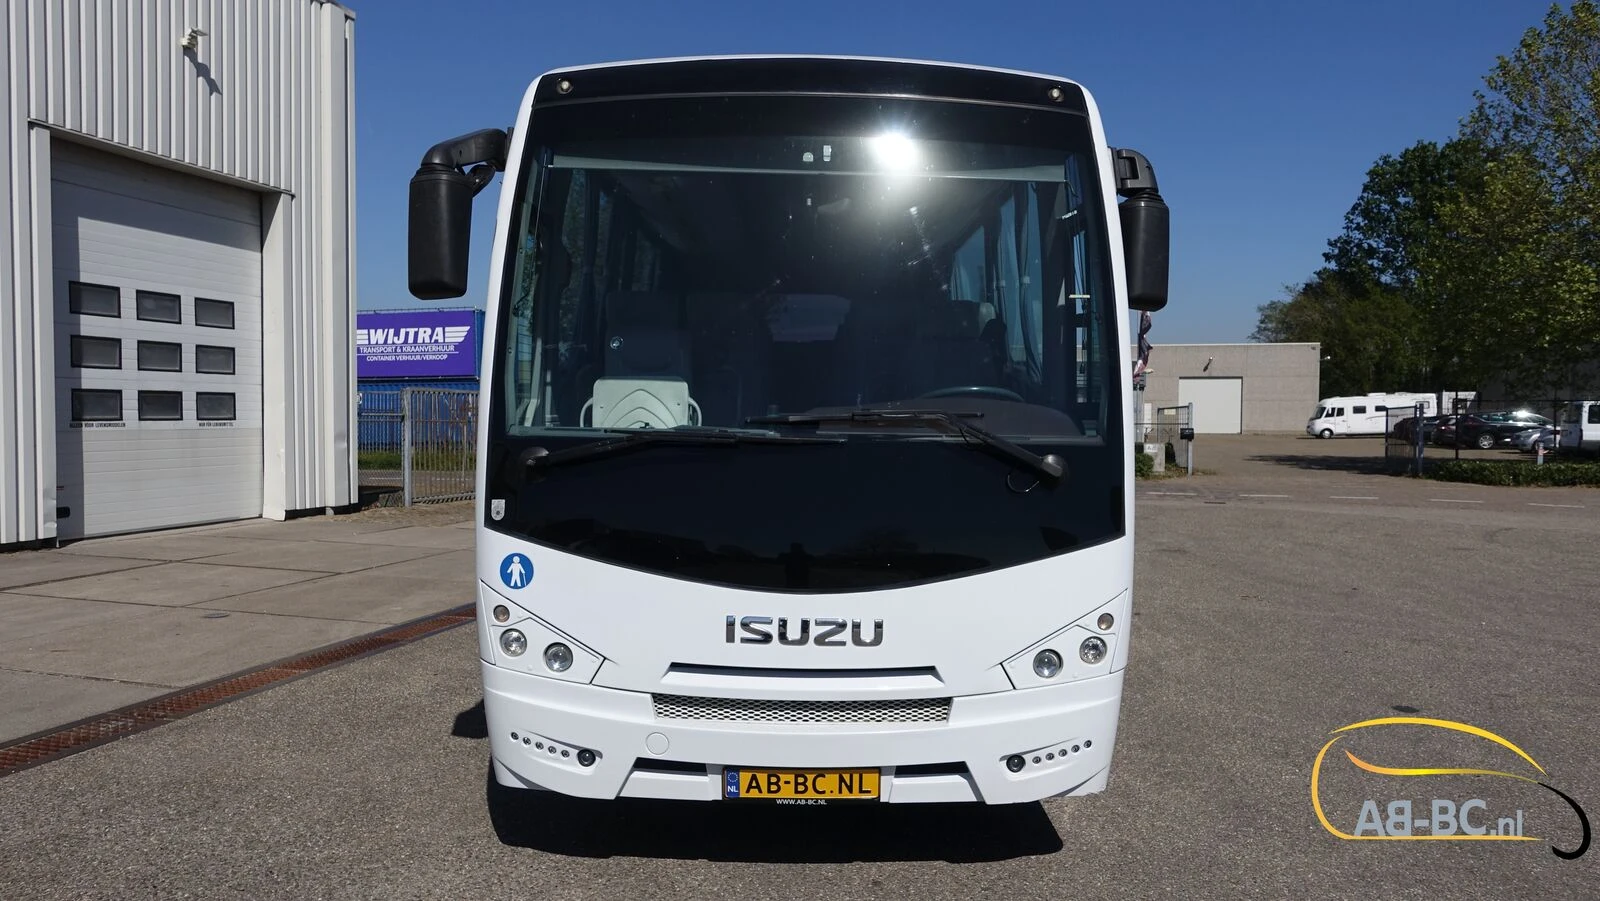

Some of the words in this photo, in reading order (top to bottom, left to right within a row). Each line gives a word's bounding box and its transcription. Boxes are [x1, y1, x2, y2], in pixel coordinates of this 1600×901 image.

[369, 327, 445, 345] WIJTRA
[360, 346, 396, 354] TRANSPORT
[725, 615, 884, 647] ISUZU
[727, 785, 739, 793] NL
[745, 773, 872, 795] AB-BC.NL
